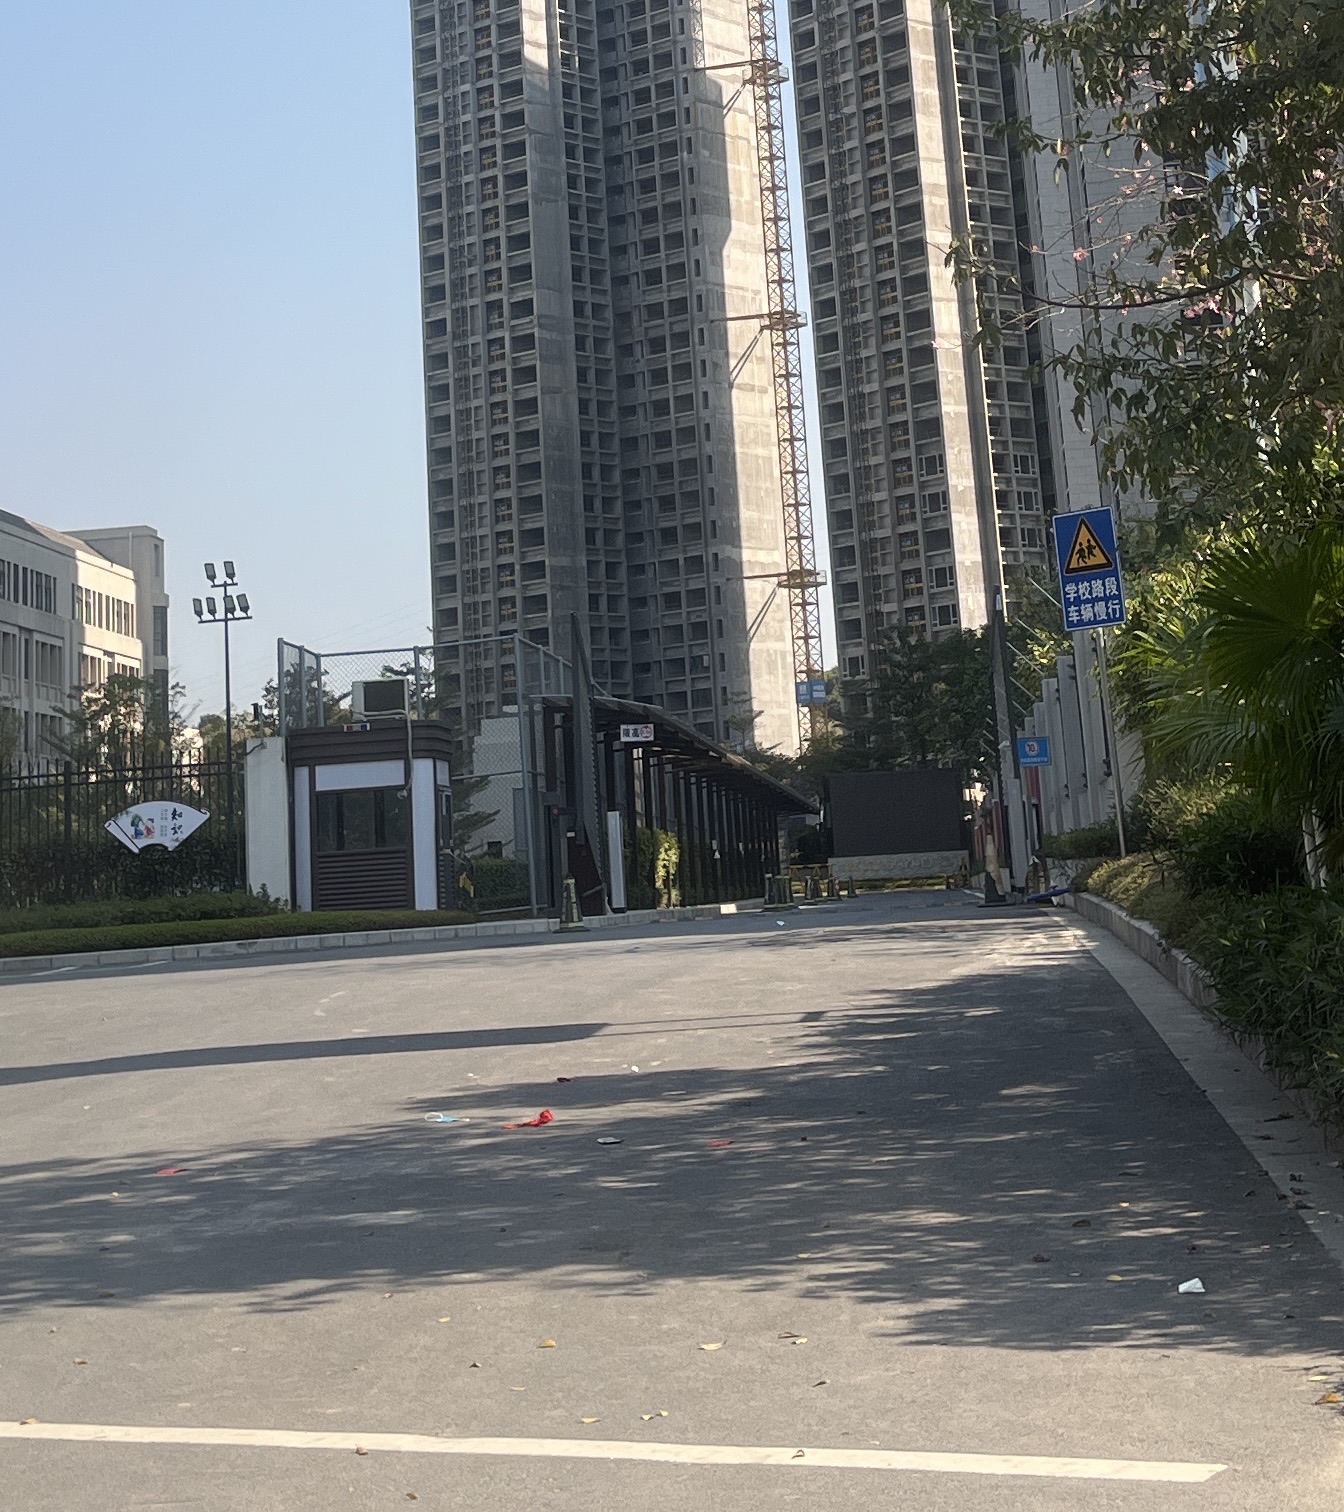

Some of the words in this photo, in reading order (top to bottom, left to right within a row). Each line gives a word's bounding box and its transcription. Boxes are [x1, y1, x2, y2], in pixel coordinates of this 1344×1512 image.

[1064, 577, 1119, 602] 学校路段
[1067, 599, 1121, 624] 车辆慢行
